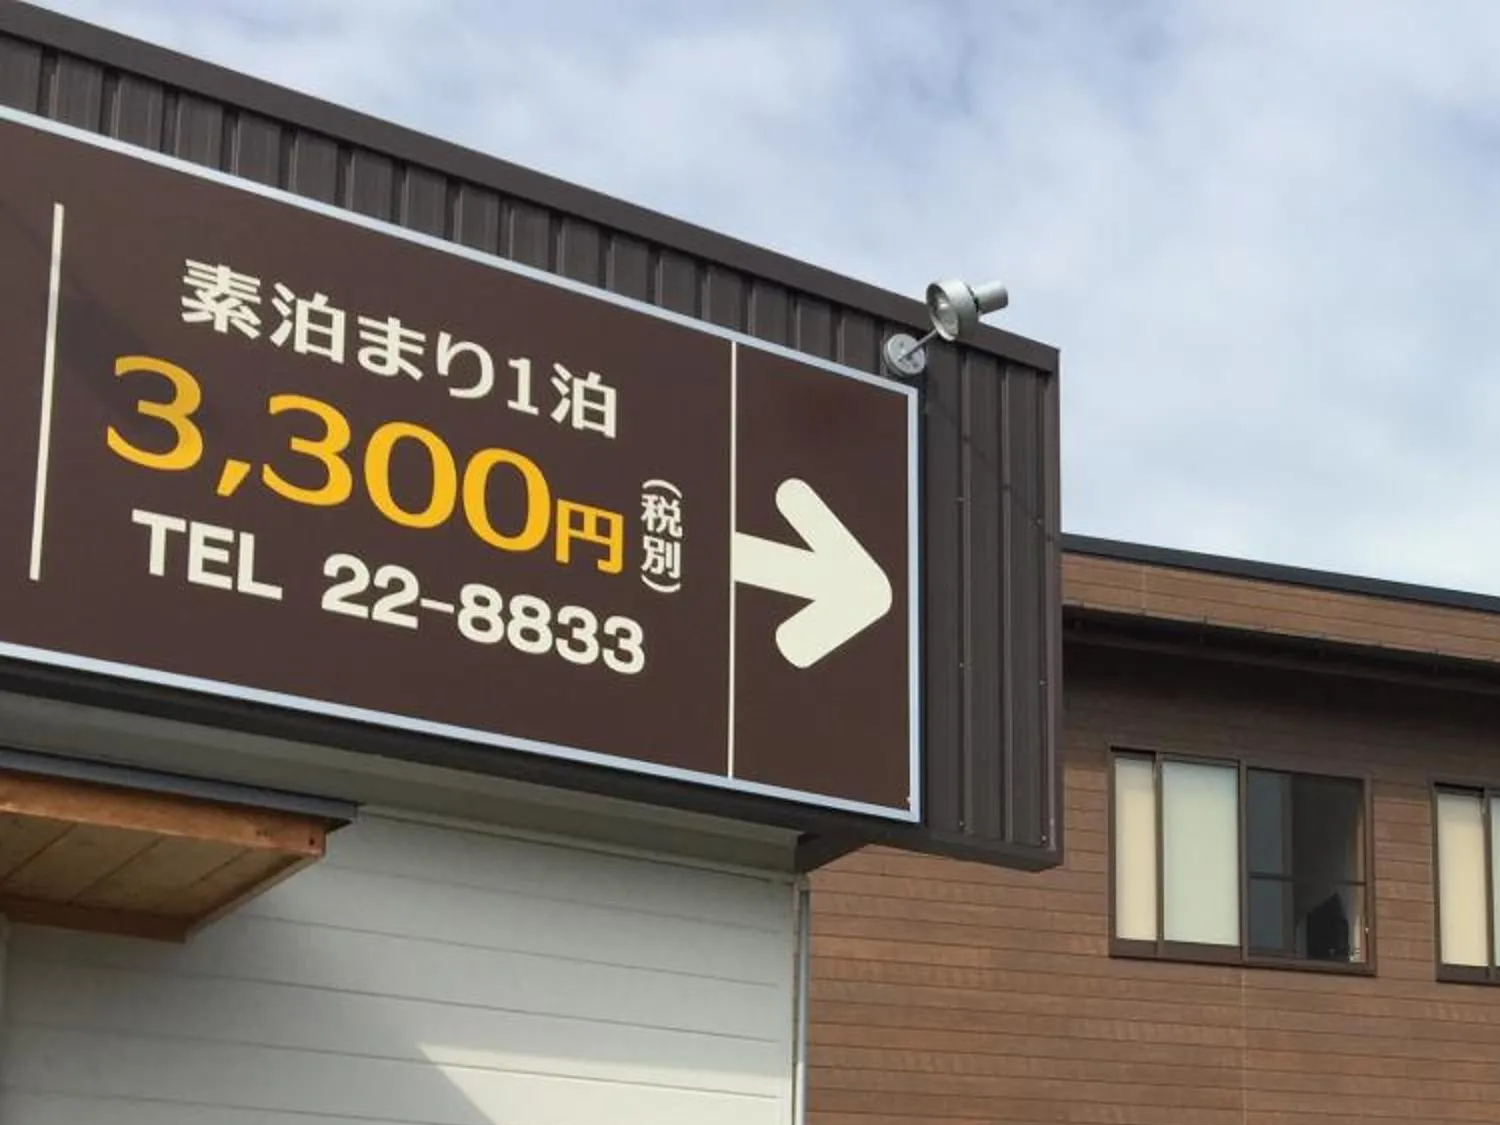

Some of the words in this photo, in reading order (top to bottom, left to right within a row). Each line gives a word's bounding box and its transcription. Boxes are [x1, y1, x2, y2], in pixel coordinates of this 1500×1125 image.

[181, 259, 619, 441] 素泊まり1泊
[106, 355, 626, 576] 3,300円
[131, 509, 284, 601] TEL
[322, 553, 646, 676] 22-8833
